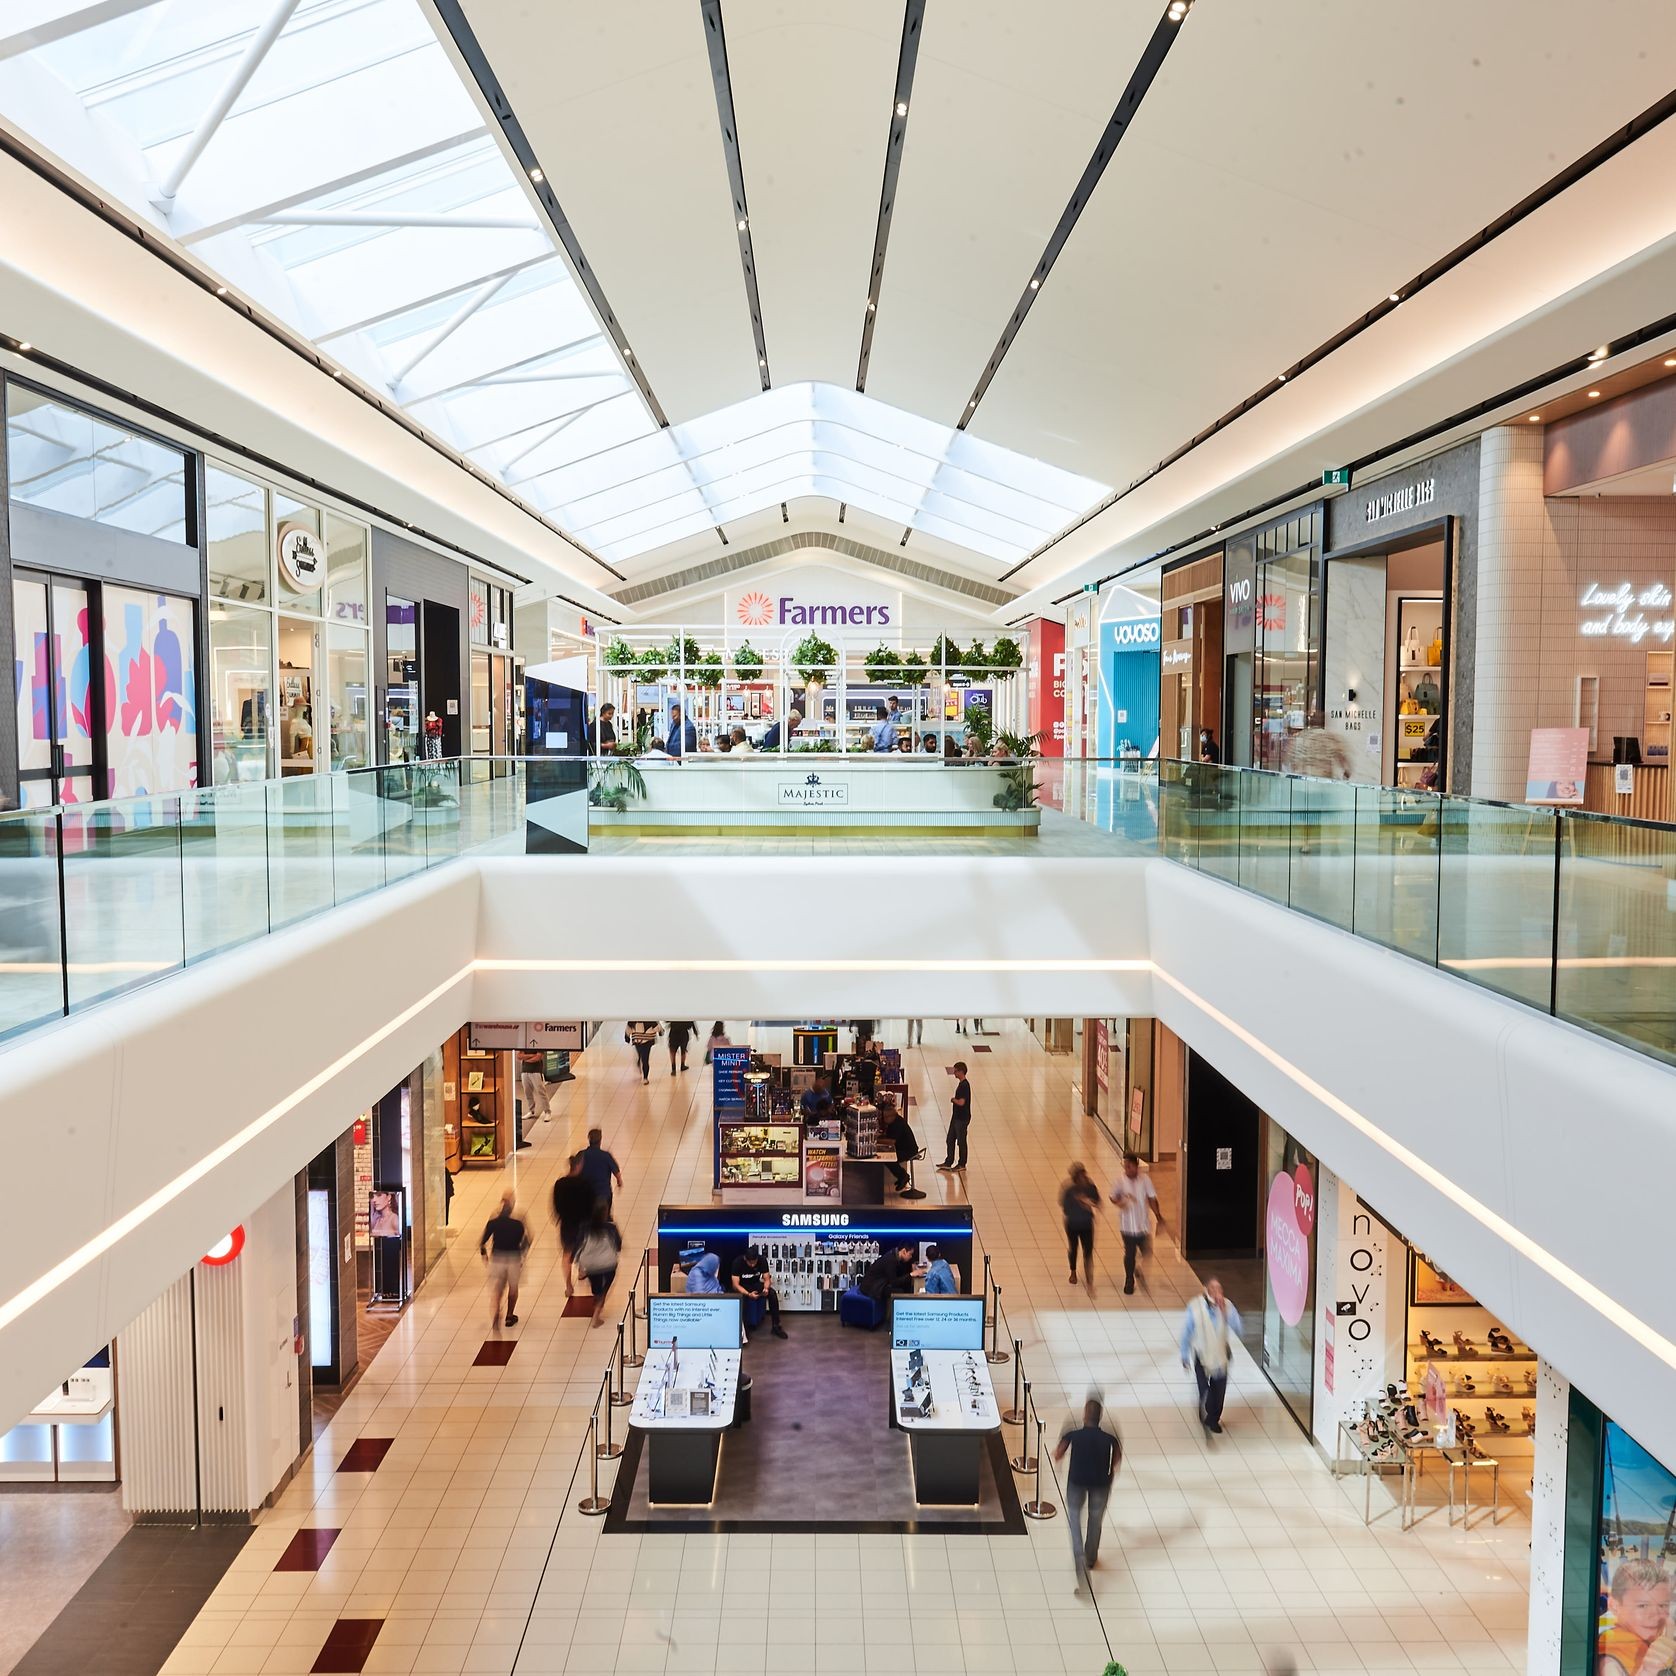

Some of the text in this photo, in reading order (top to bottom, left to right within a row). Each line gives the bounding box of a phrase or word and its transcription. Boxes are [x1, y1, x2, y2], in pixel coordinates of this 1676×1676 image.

[1580, 583, 1673, 614] Lovely skin
[778, 597, 890, 625] Farmers
[1581, 614, 1614, 635] and
[1613, 613, 1651, 644] body
[1330, 710, 1376, 720] SAN MICHELLE
[1344, 722, 1361, 730] BAGS
[1406, 724, 1424, 734] $25
[783, 789, 844, 800] MAJESTIC
[544, 1022, 576, 1032] Farmers
[782, 1214, 850, 1226] SAMSUNG
[1270, 1212, 1300, 1255] MECCA
[1270, 1238, 1303, 1290] MAXIMA
[1349, 1214, 1374, 1341] novo
